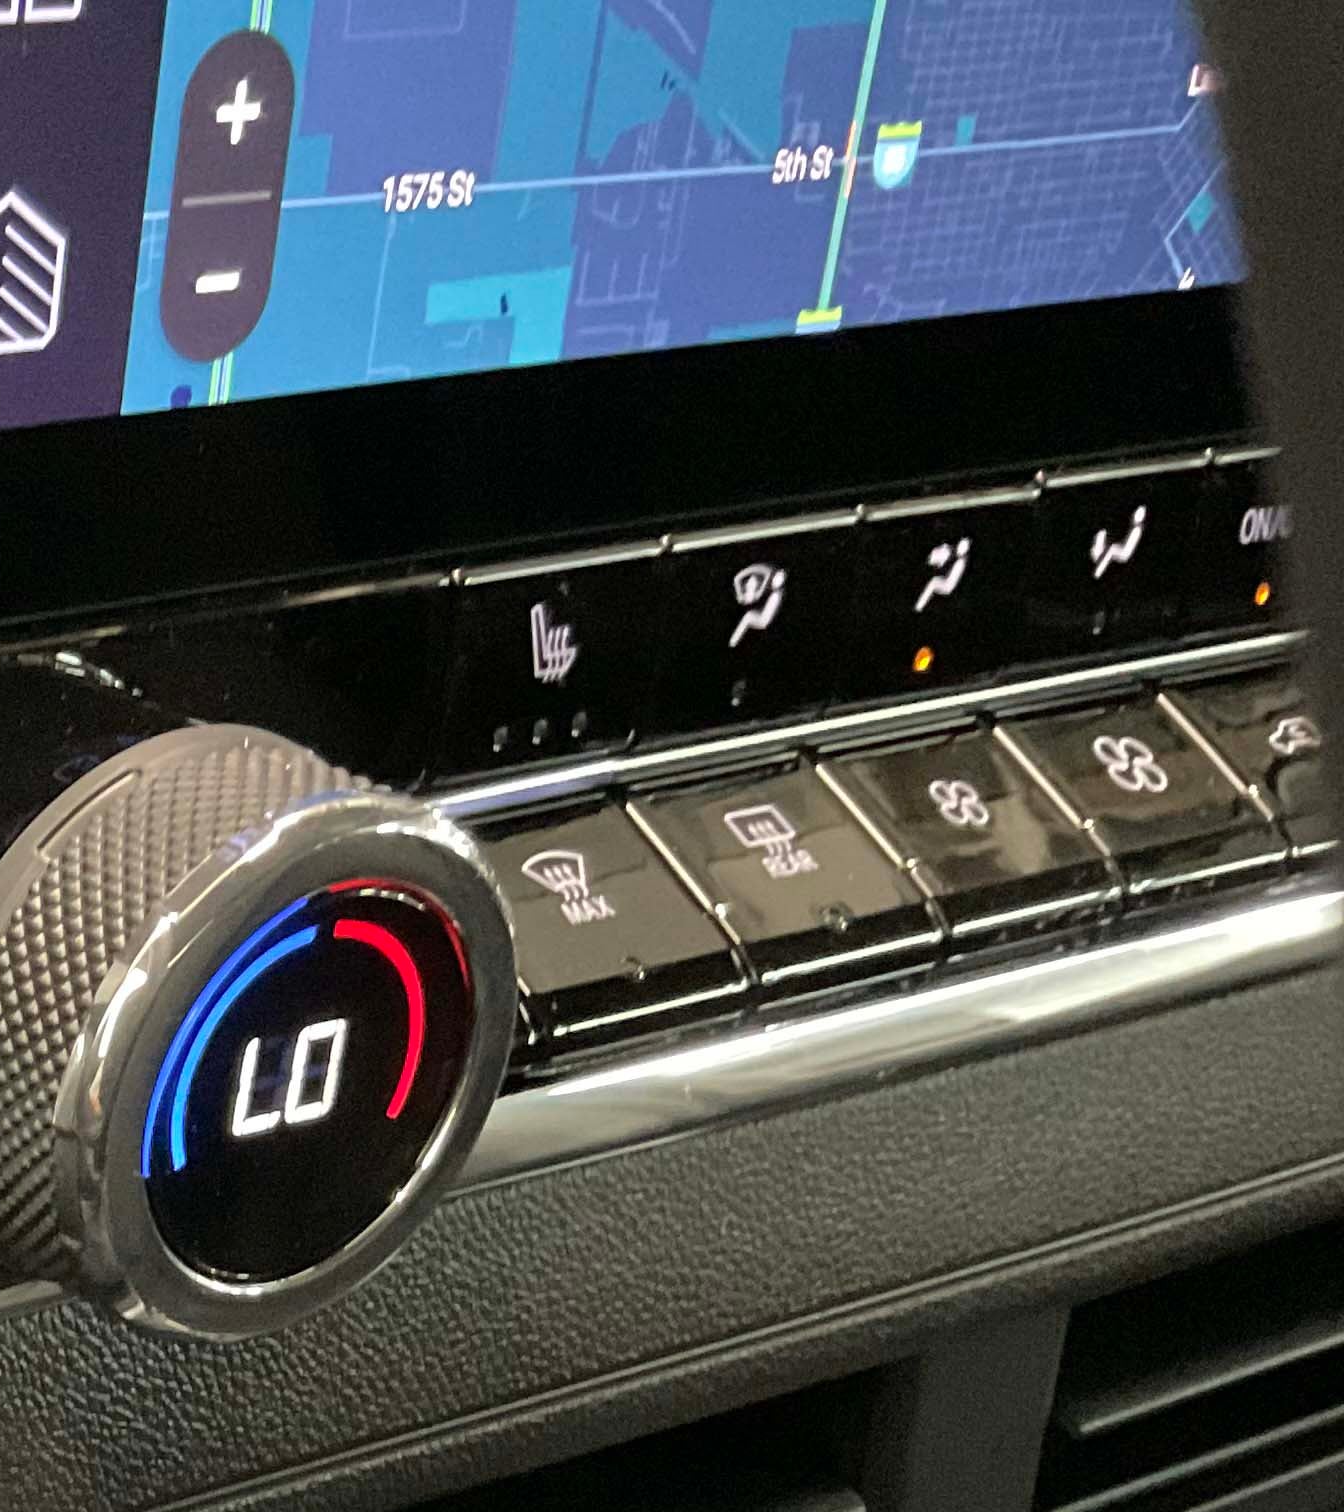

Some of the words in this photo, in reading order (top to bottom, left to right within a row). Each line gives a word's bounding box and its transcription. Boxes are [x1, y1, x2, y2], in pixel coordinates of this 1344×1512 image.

[772, 148, 808, 184] 5th
[810, 145, 834, 180] St
[383, 170, 445, 213] 1575
[447, 169, 475, 208] St
[561, 894, 615, 926] MAX
[232, 1018, 348, 1137] LO
